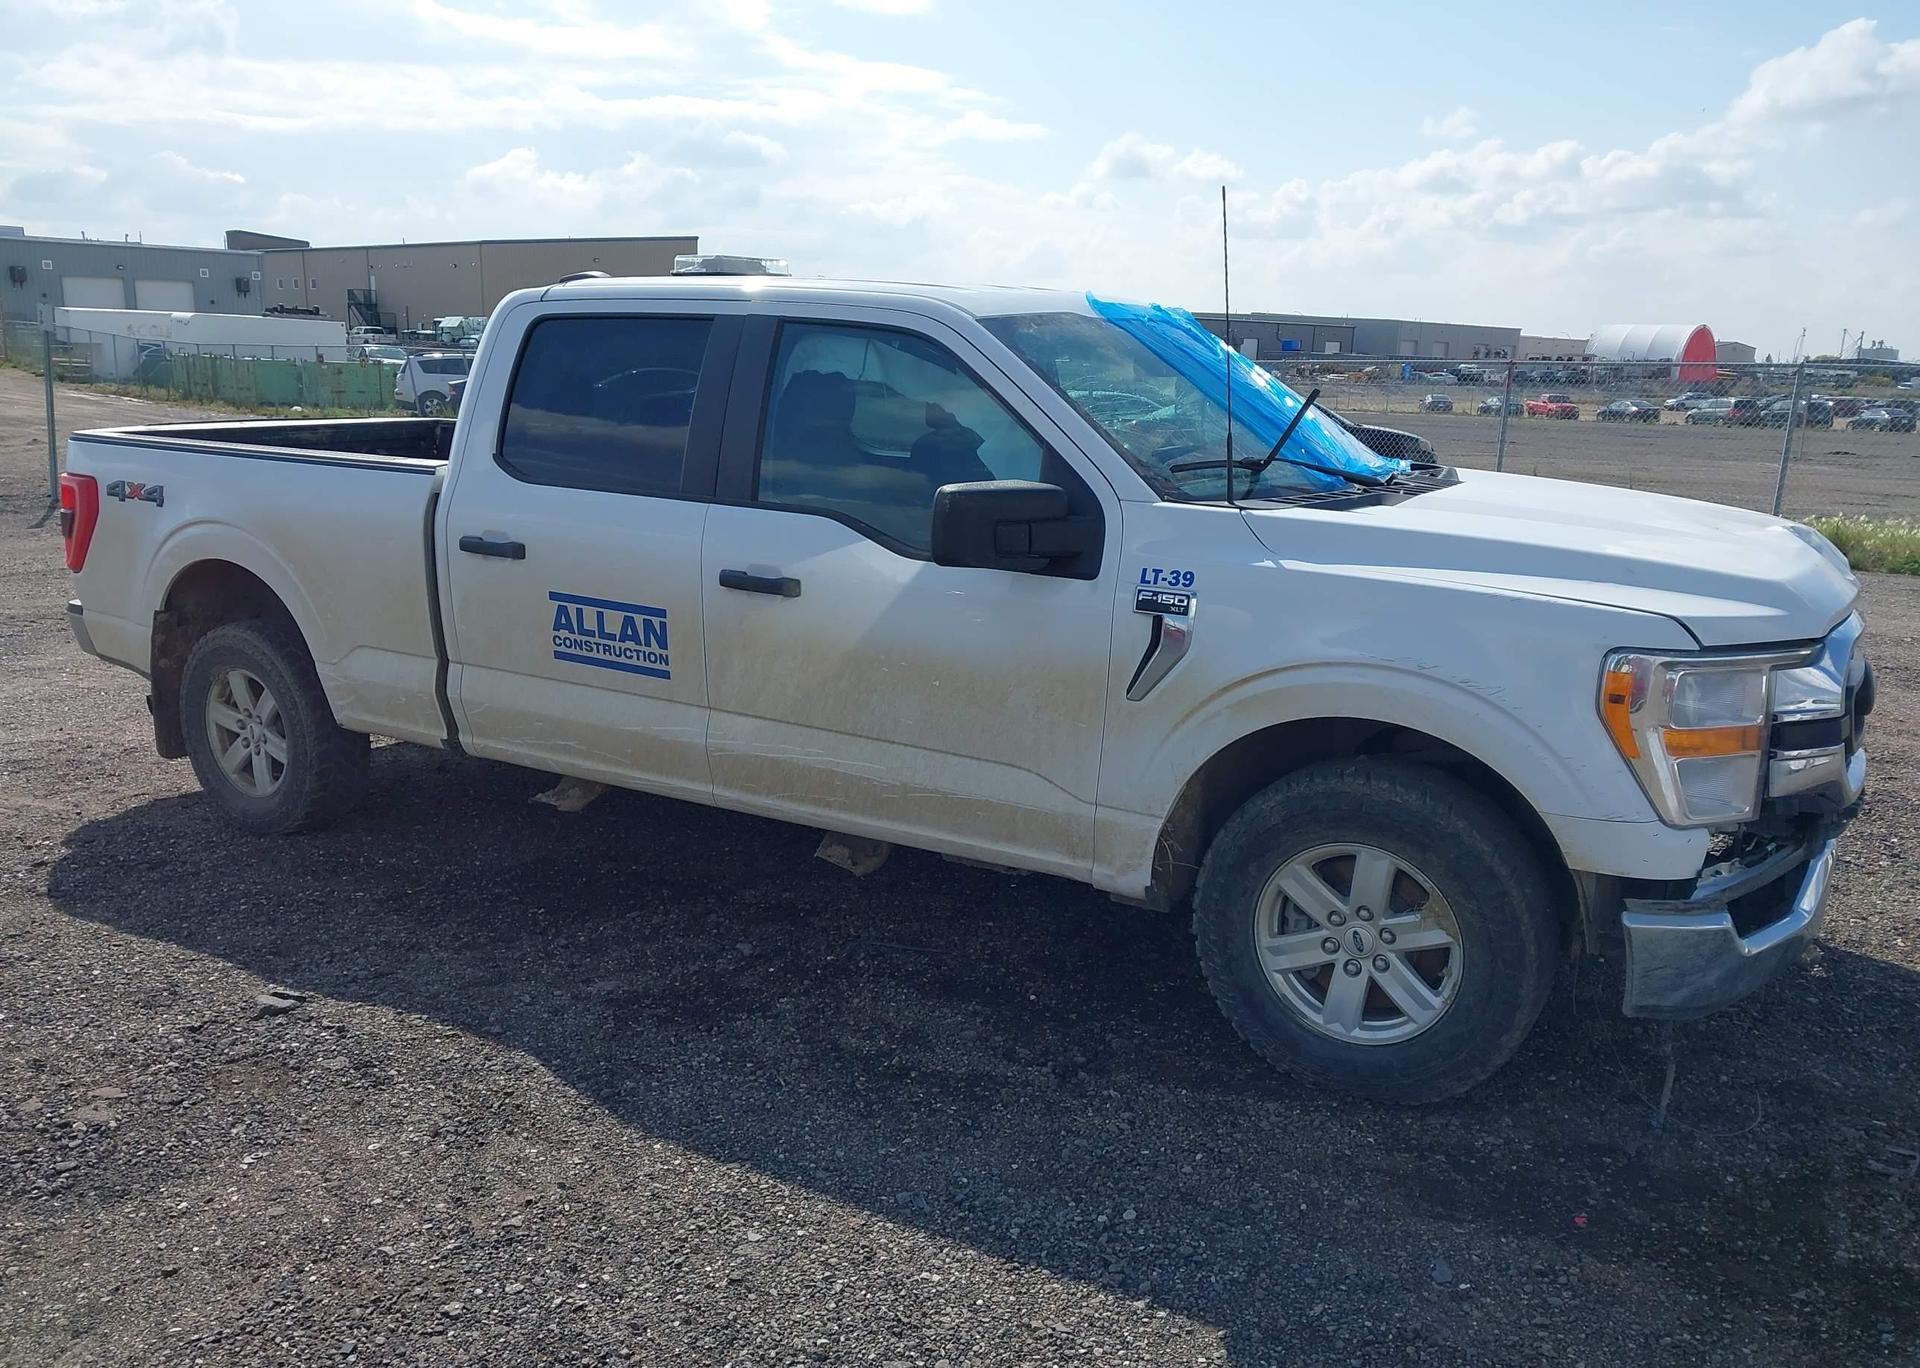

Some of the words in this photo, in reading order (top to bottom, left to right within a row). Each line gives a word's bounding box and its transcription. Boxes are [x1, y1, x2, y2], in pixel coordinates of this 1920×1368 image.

[1140, 567, 1195, 588] LT-39
[1138, 591, 1188, 606] F-150
[552, 604, 669, 651] ALLAN
[552, 634, 670, 666] CONSTRUCTION
